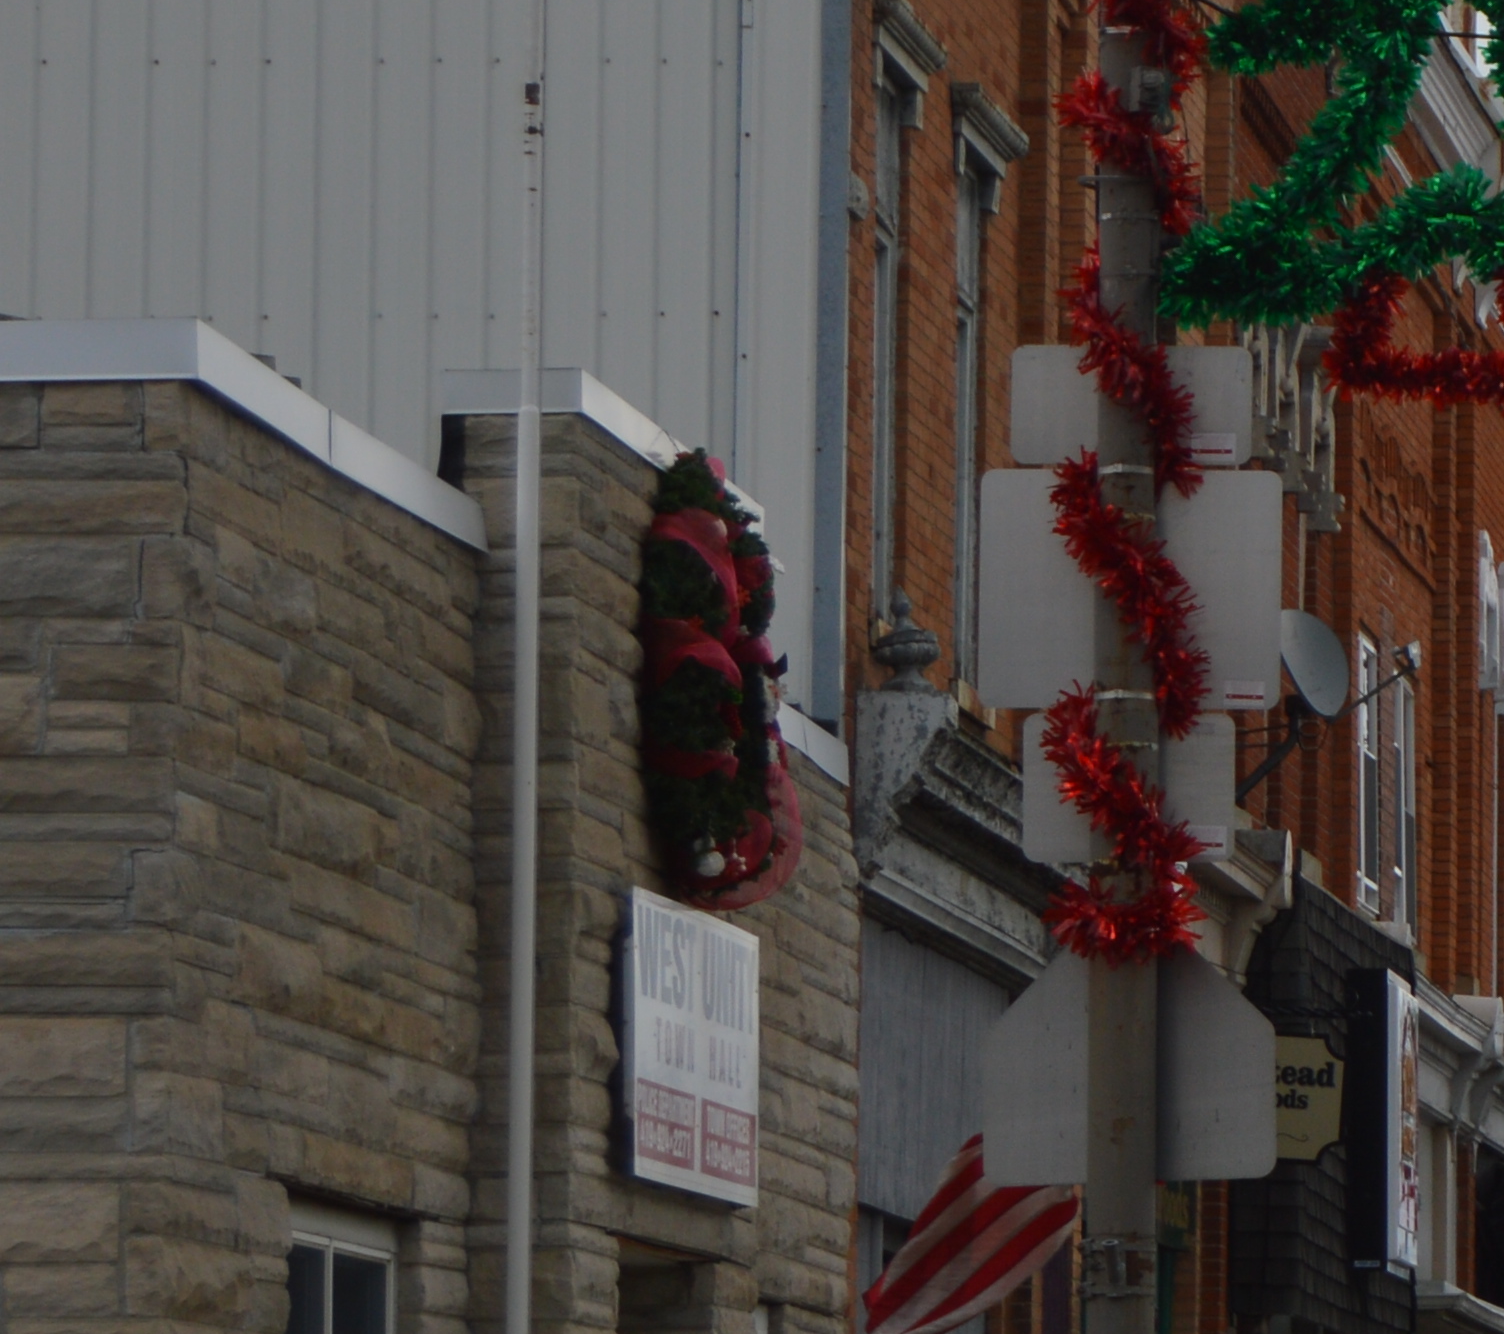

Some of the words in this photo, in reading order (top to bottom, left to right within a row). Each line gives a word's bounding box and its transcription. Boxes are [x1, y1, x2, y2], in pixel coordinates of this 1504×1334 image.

[638, 903, 697, 1013] WEST
[656, 1015, 695, 1074] TOWN
[709, 1035, 742, 1089] HALL
